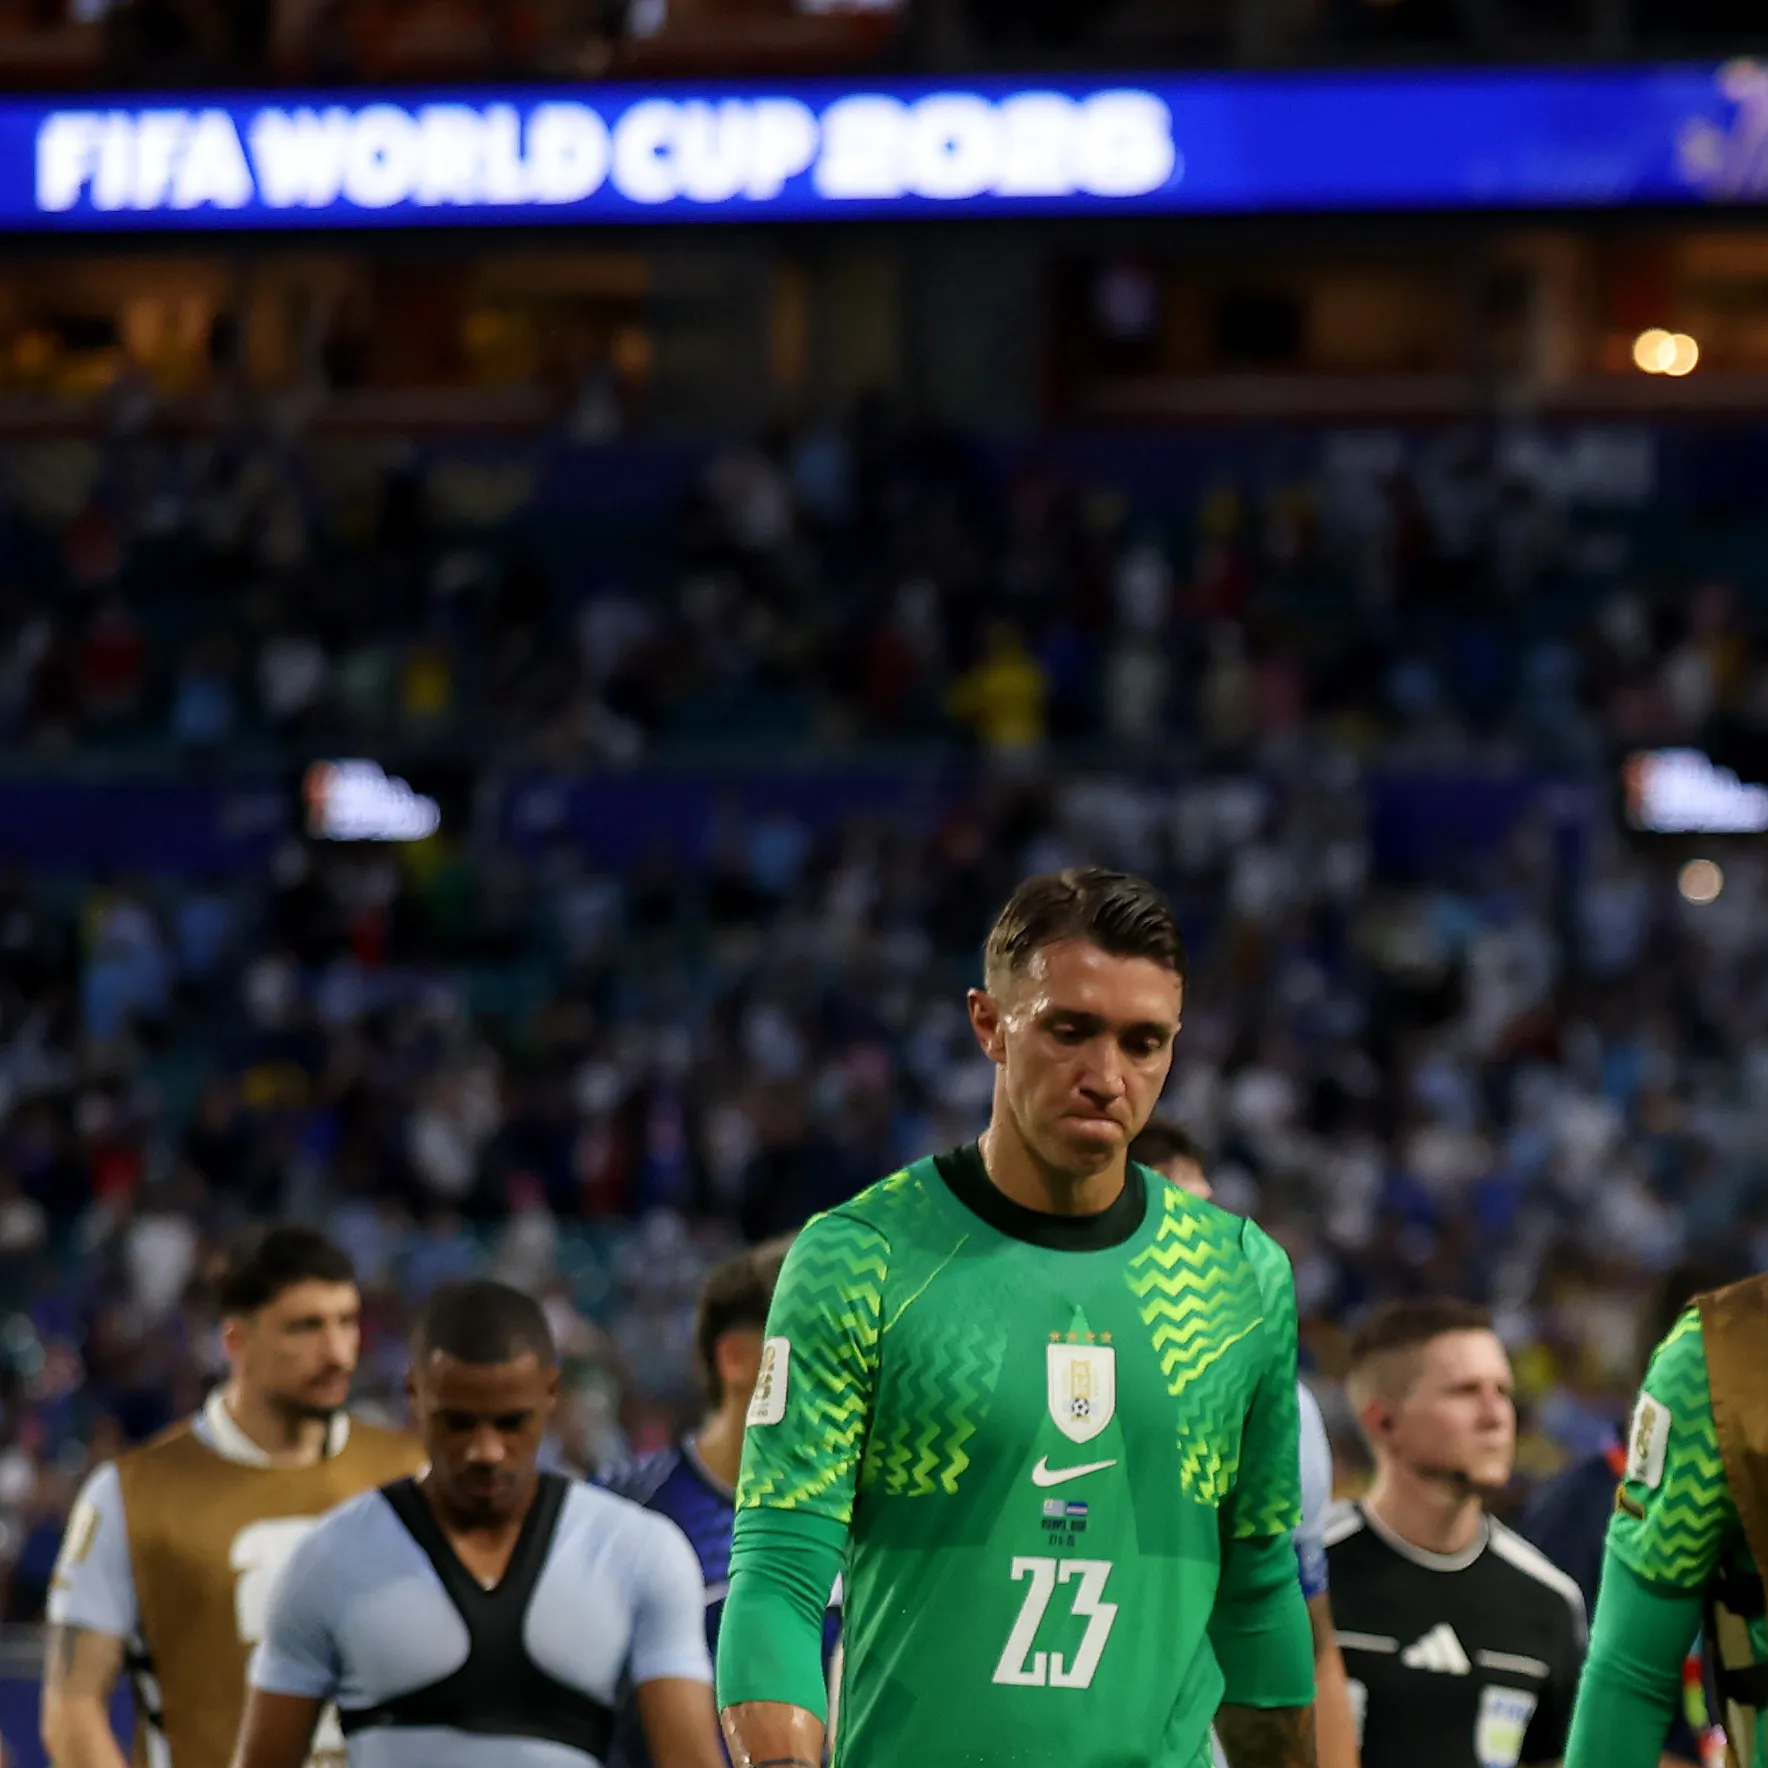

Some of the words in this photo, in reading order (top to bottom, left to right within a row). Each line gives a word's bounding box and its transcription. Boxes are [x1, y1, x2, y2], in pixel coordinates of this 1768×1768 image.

[35, 107, 252, 213] FIFA
[252, 101, 612, 209] WORLD
[609, 96, 819, 204] CUP
[814, 88, 1178, 200] 2026
[991, 1556, 1118, 1690] 23
